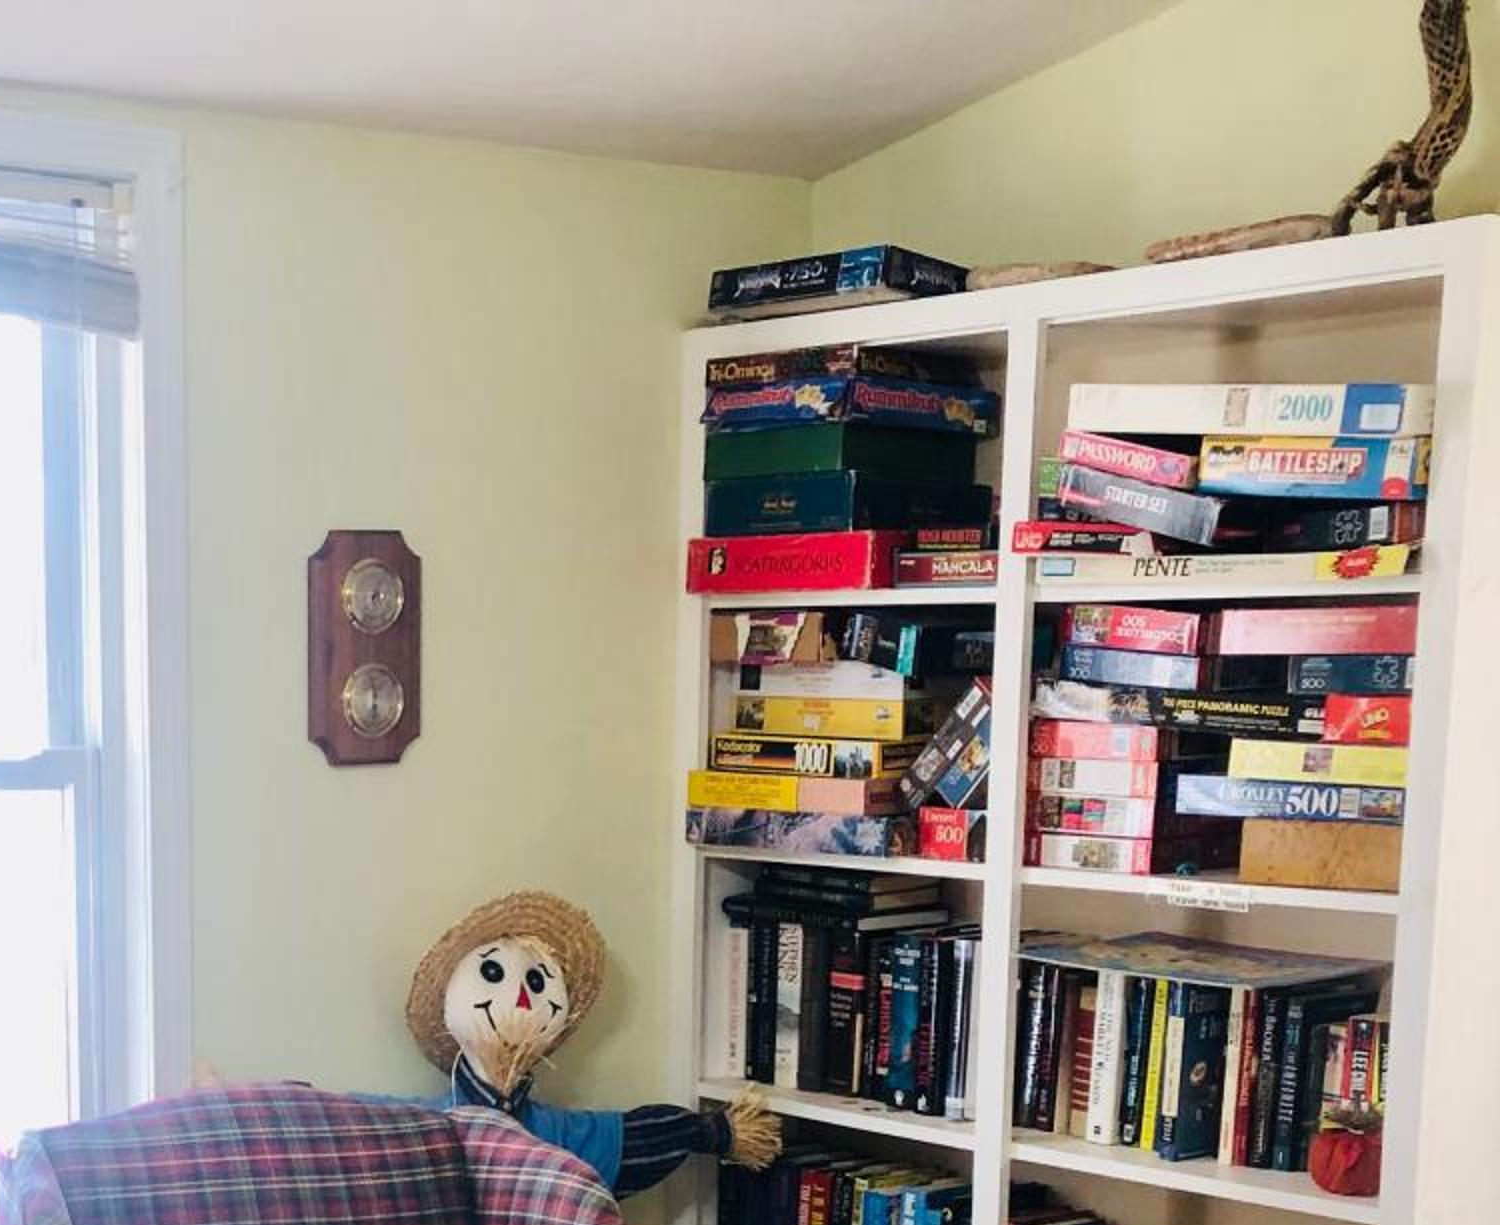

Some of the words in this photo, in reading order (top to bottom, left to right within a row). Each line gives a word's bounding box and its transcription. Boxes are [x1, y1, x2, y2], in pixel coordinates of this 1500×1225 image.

[1279, 395, 1333, 421] 2000
[1076, 438, 1157, 471] PASSWORD
[1247, 449, 1363, 475] BATTLESHIP
[1103, 484, 1143, 510] STARTER
[931, 557, 995, 576] MANCALA
[1133, 557, 1192, 577] PENTE
[1300, 677, 1326, 690] 500
[1197, 700, 1260, 716] PANORAMIC
[793, 744, 828, 772] 1000
[1284, 786, 1338, 816] 500
